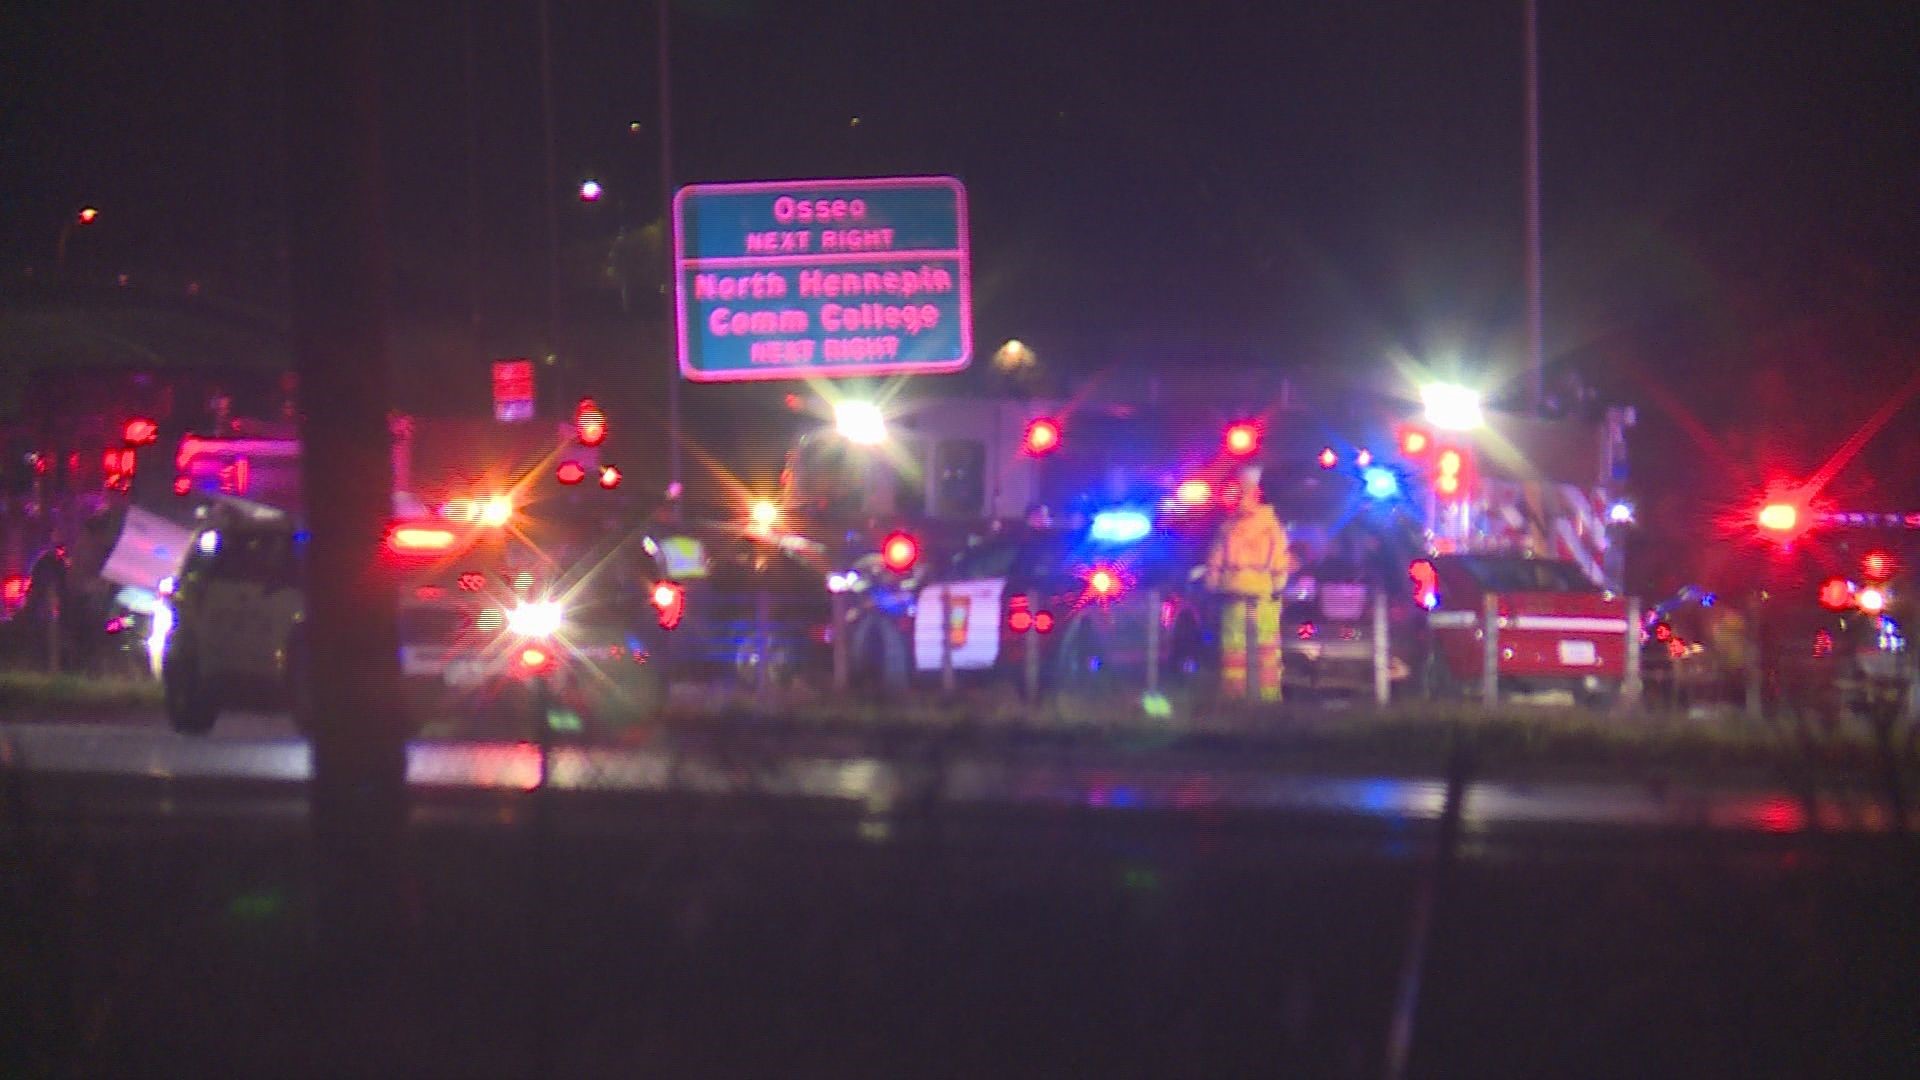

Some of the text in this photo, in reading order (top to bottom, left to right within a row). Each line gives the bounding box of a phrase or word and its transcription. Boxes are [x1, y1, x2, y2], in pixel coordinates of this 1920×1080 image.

[773, 196, 867, 223] Osseo
[746, 228, 894, 251] NEXT RIGHT
[694, 266, 951, 300] North Hennepin
[709, 303, 940, 336] Comm College
[751, 336, 898, 363] NEXT RIGHT
